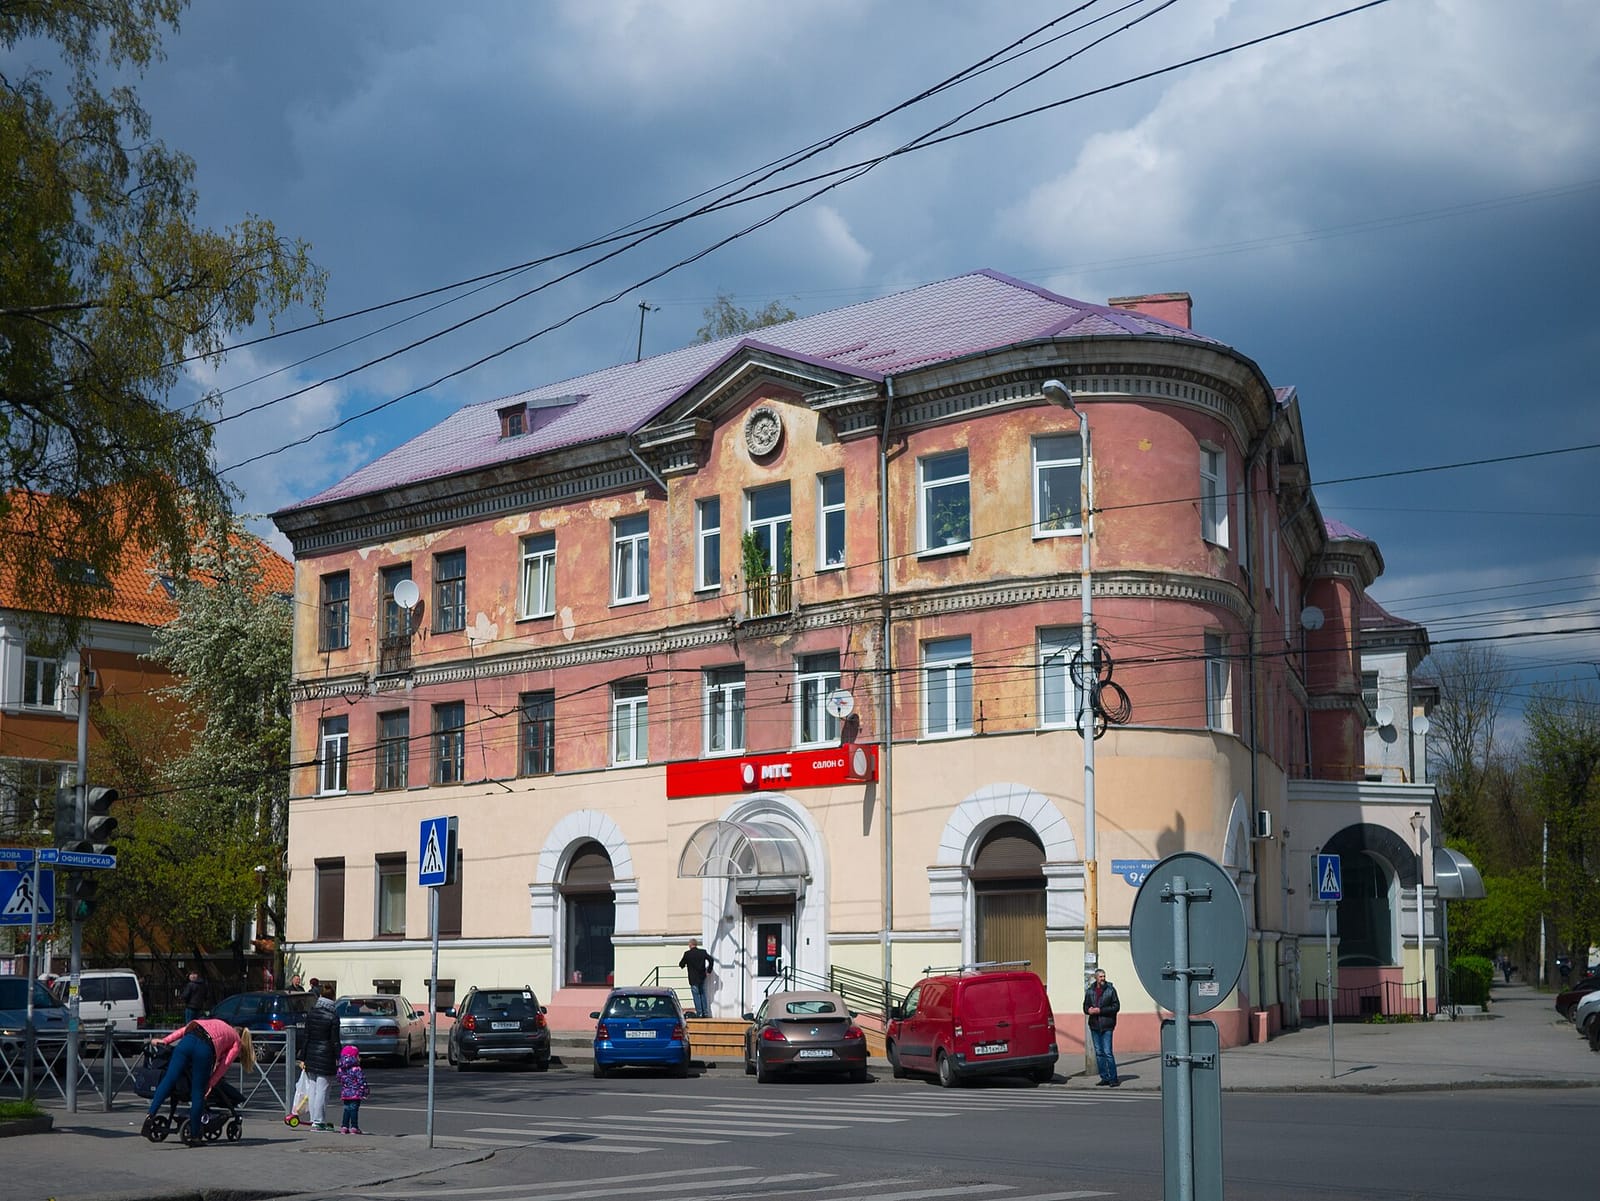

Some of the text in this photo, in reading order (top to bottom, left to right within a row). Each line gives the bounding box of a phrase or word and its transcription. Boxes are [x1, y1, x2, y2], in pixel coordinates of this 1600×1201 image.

[761, 763, 791, 779] МТС
[812, 759, 836, 769] салон
[0, 851, 21, 859] ЗОВА
[61, 854, 111, 865] ОФИЦЕРСКАЯ
